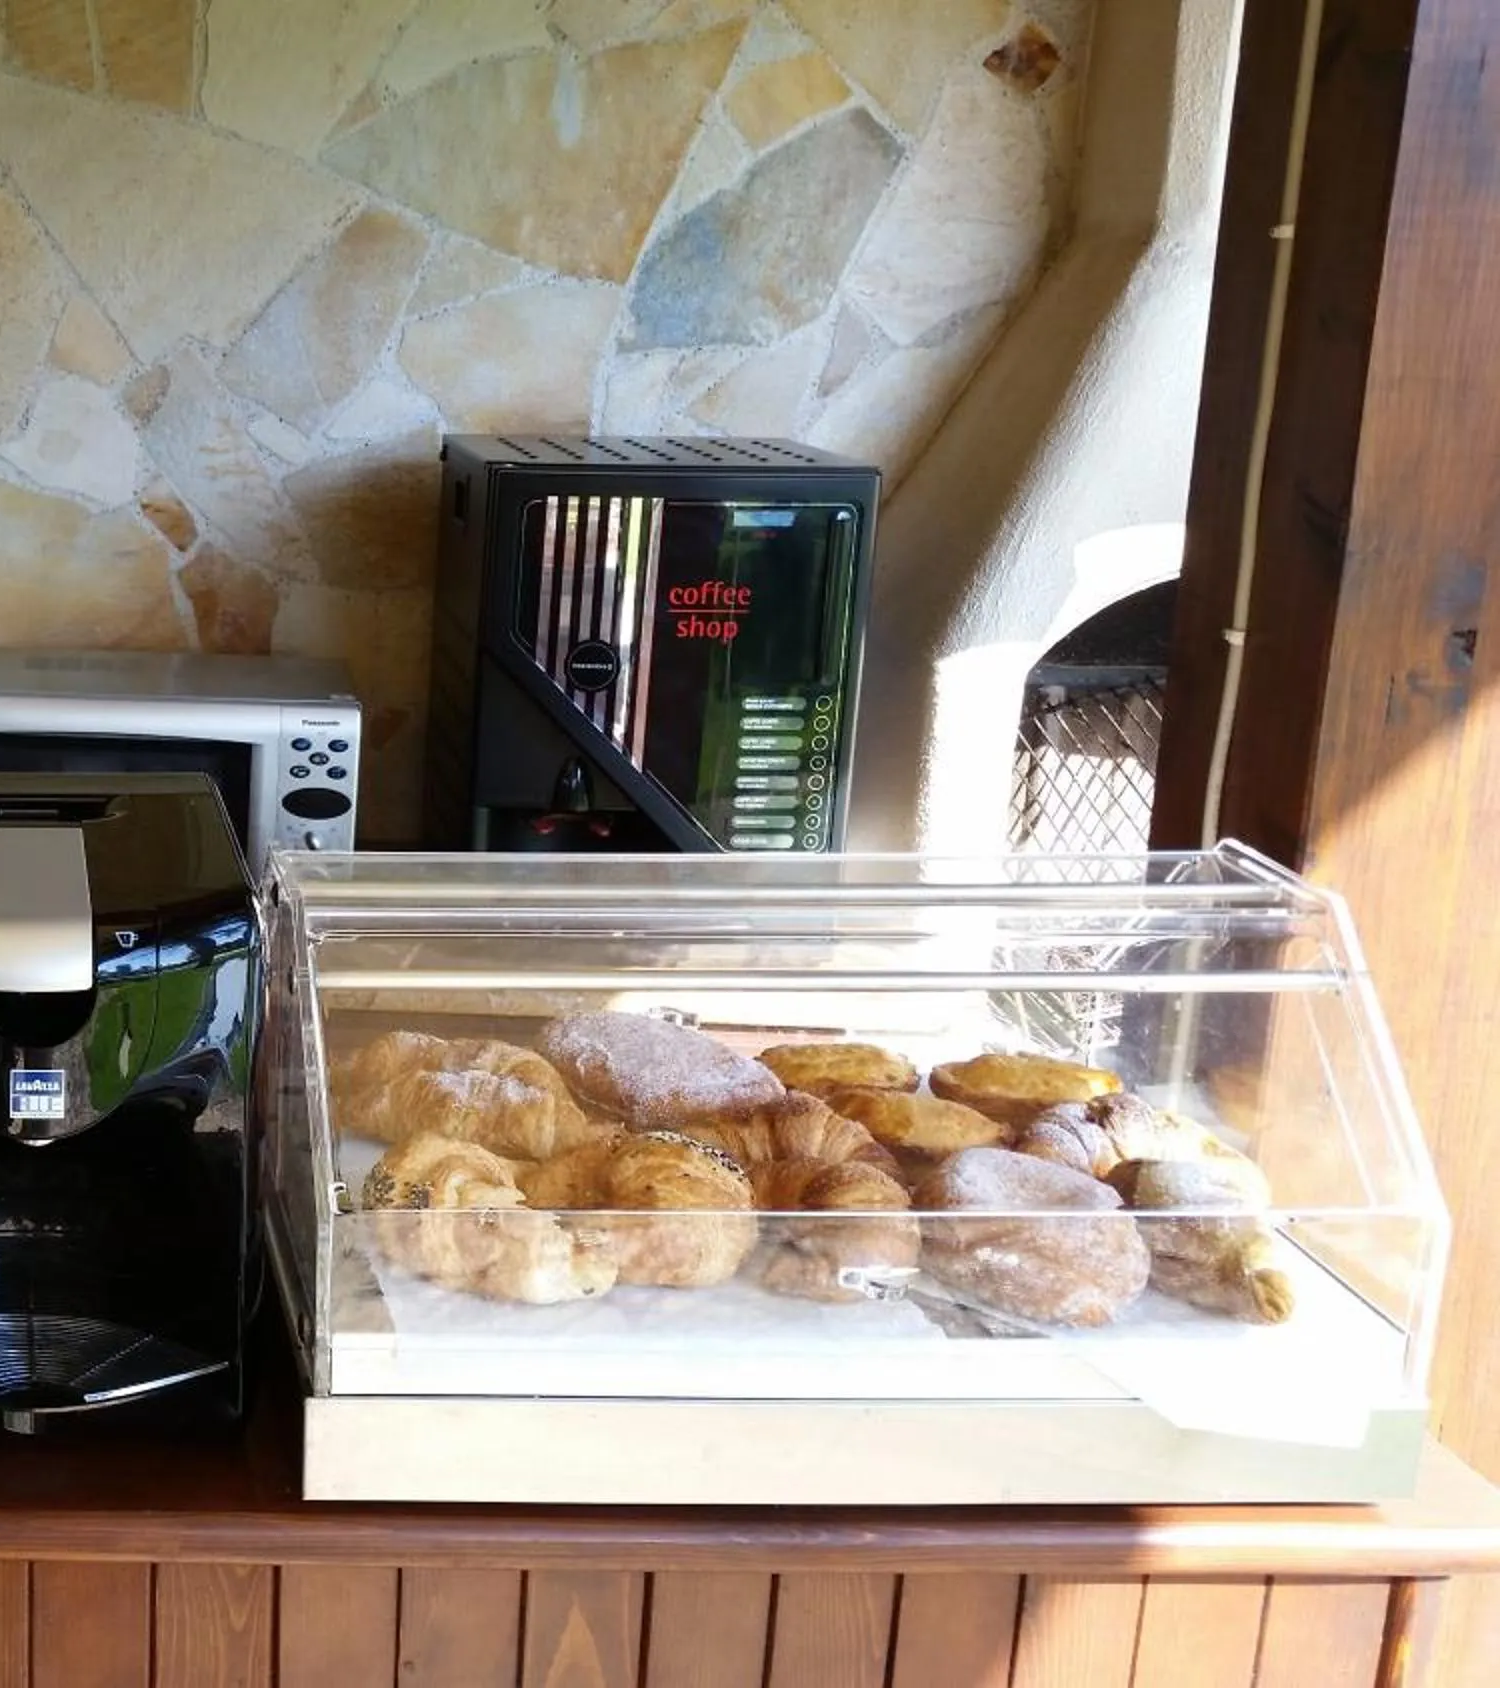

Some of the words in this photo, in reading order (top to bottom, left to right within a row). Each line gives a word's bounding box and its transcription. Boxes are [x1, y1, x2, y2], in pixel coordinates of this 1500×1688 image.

[668, 580, 752, 606] coffee
[675, 613, 739, 645] shop
[14, 1079, 61, 1091] LAVAZZA
